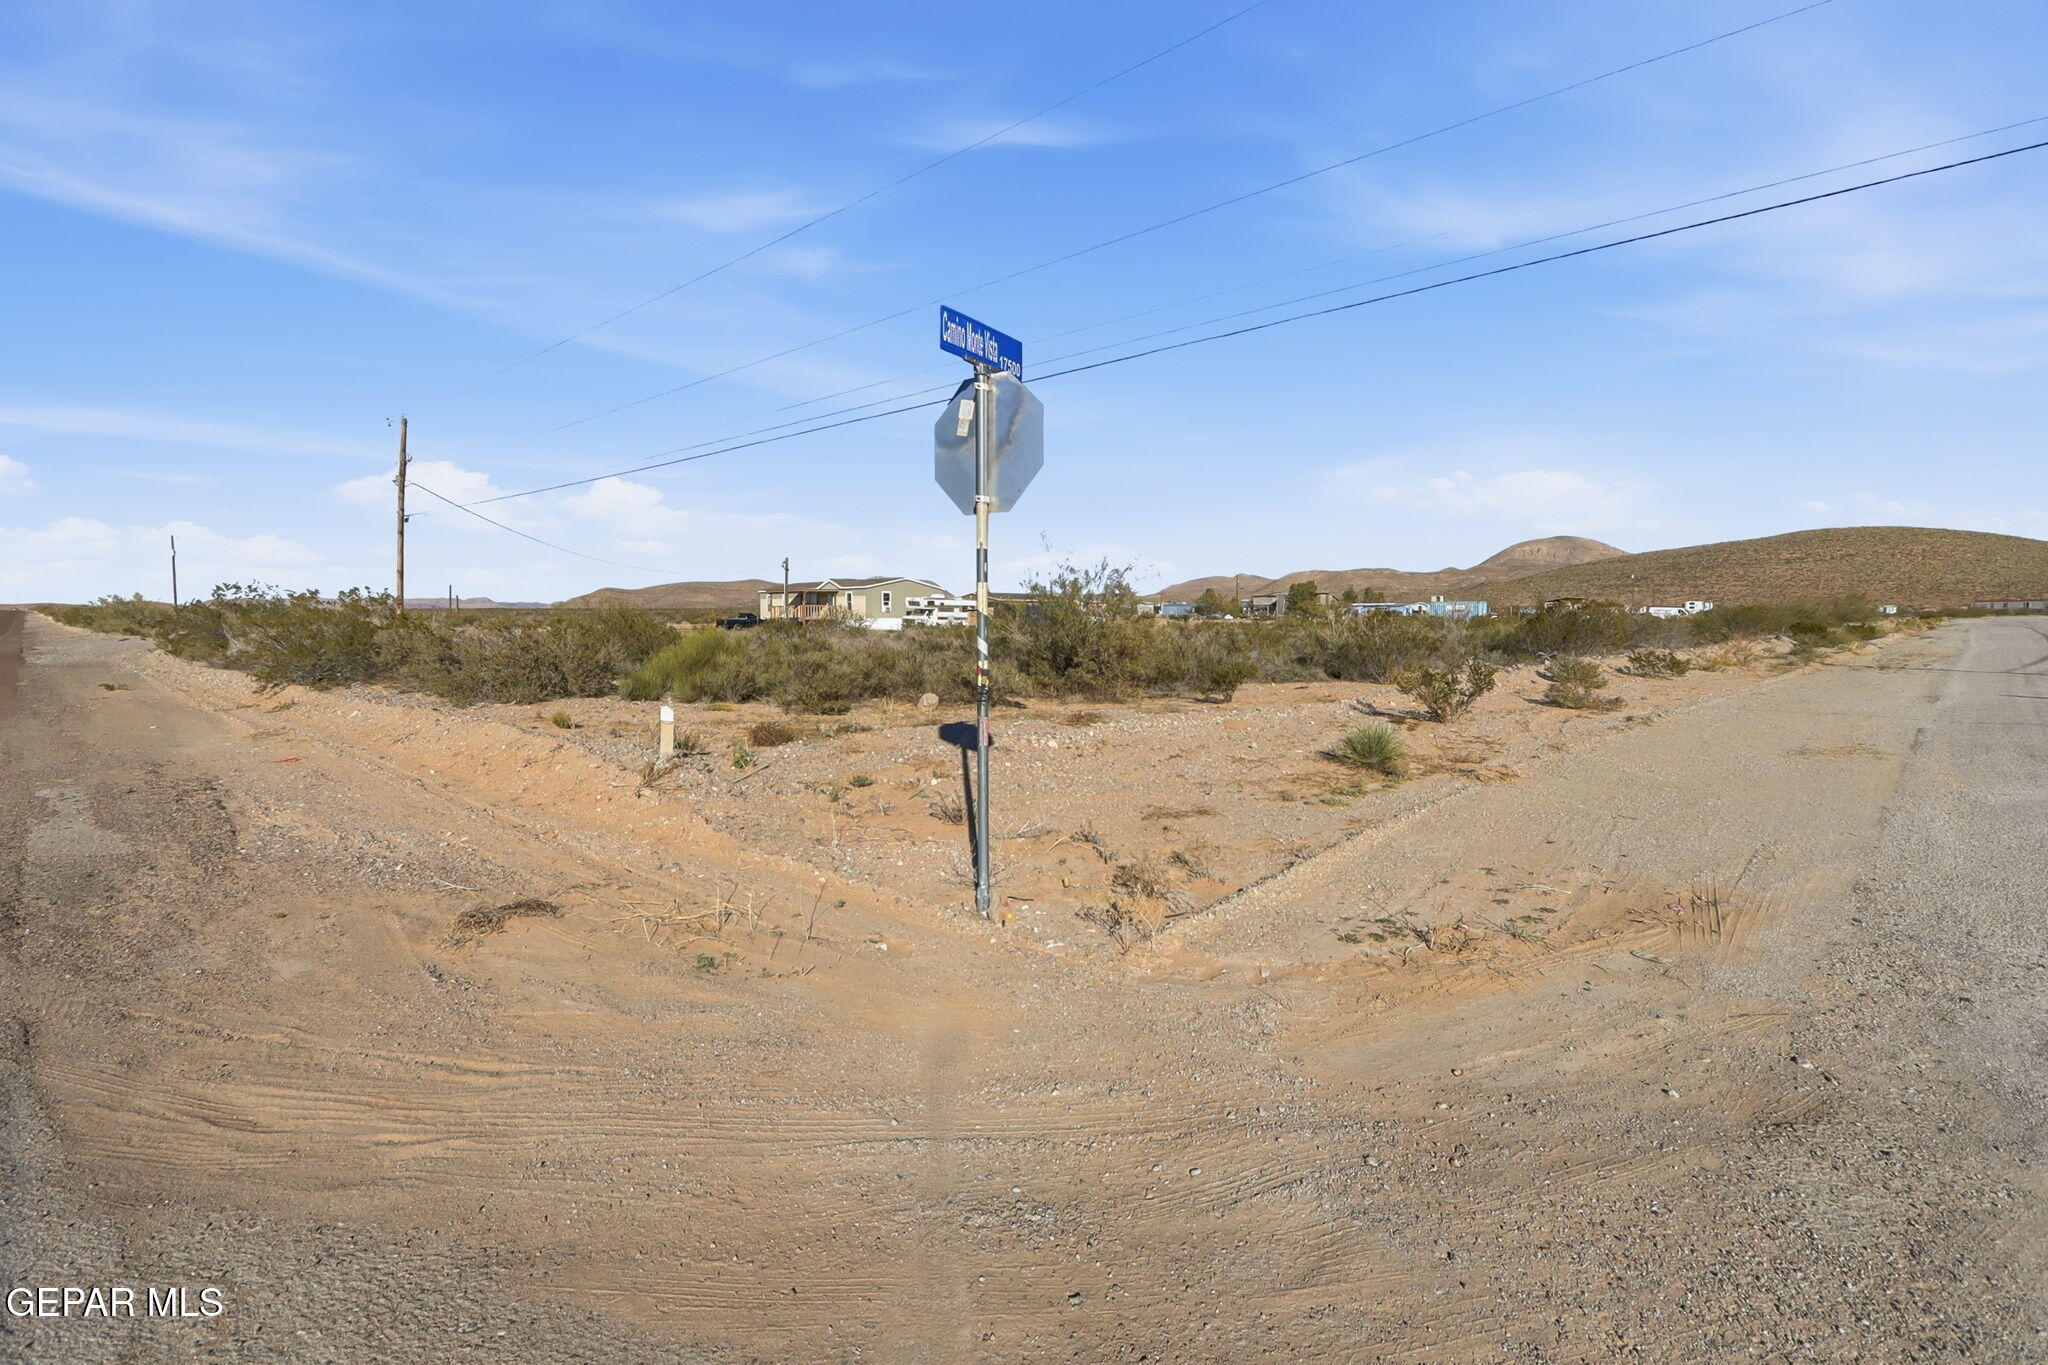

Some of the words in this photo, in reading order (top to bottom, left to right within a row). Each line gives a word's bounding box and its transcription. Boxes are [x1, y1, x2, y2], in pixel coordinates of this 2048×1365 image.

[942, 311, 965, 349] Camino
[966, 321, 983, 356] Monte
[984, 330, 998, 363] Vista
[999, 356, 1021, 377] 17500
